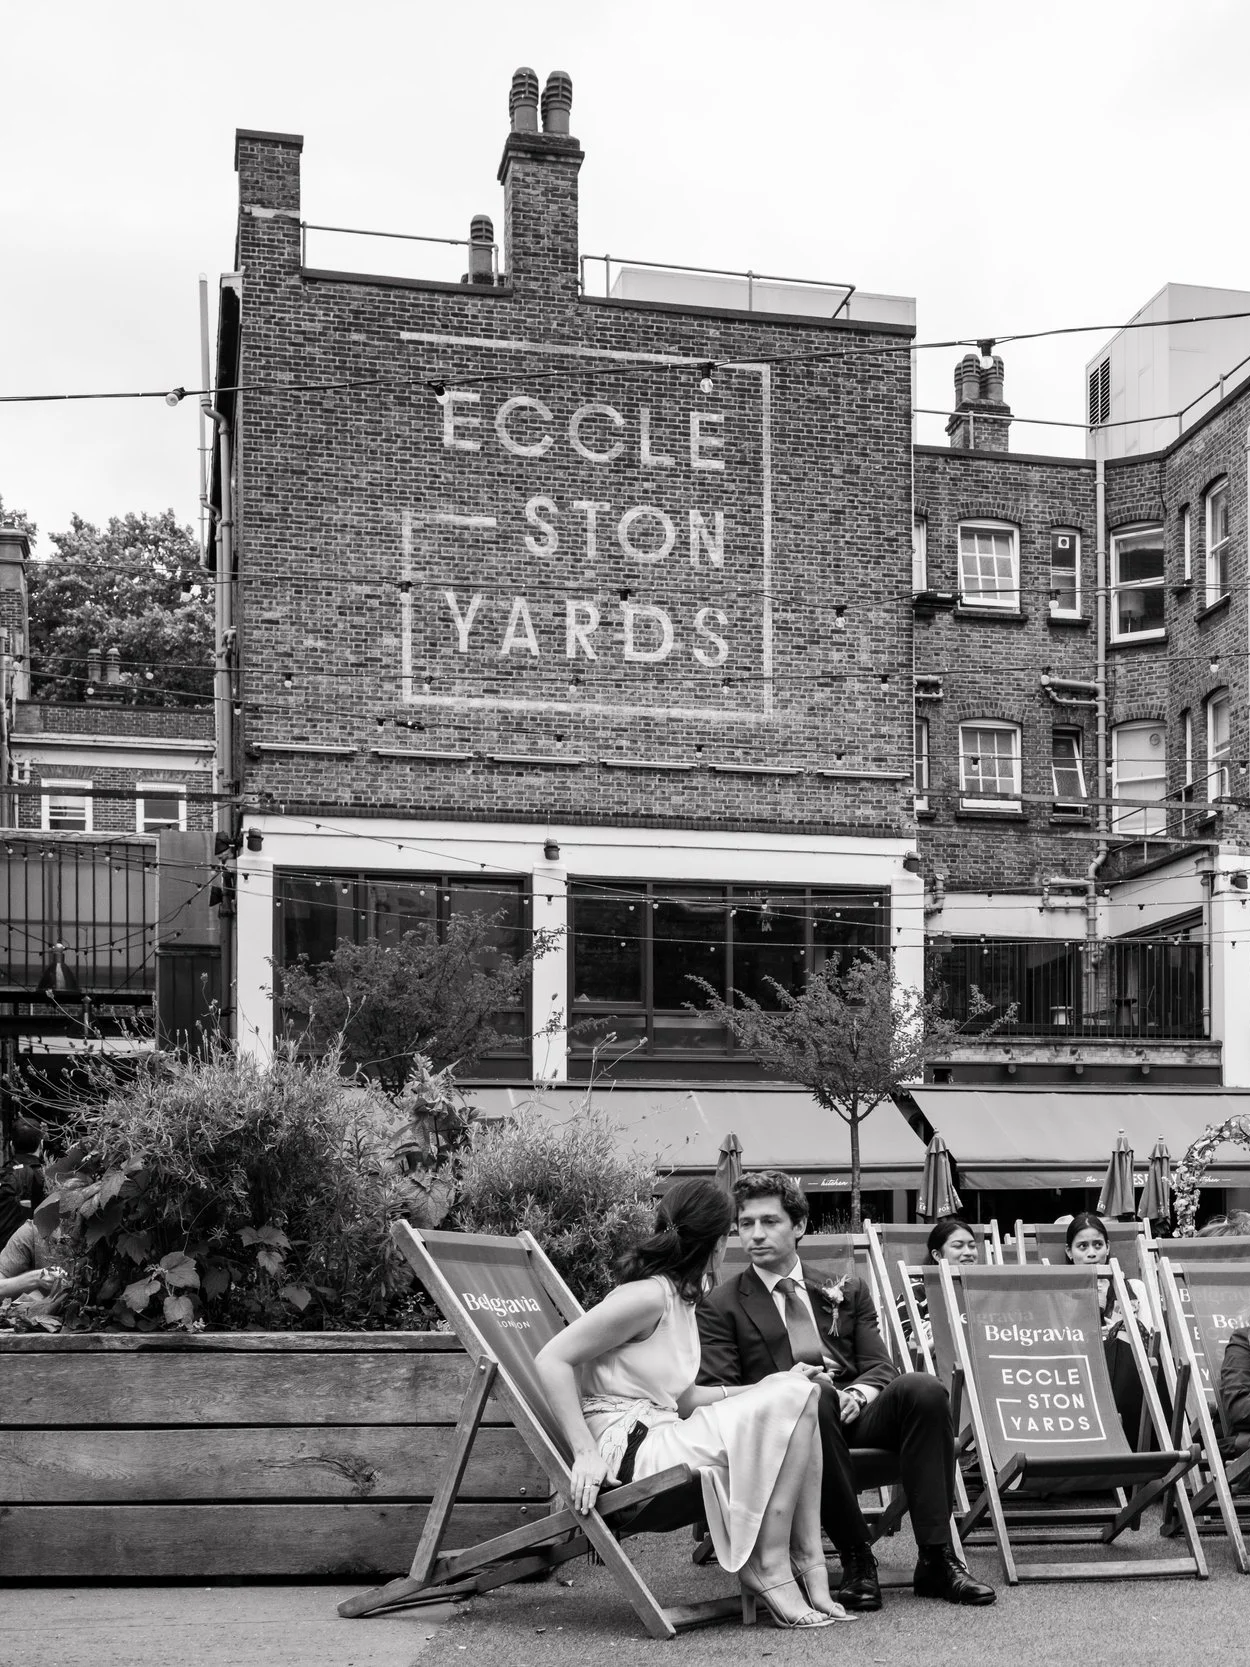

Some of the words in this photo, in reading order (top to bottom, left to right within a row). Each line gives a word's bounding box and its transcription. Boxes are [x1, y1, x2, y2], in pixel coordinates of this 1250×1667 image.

[443, 391, 725, 469] ECCLE
[524, 495, 725, 567] STON
[444, 591, 729, 667] YARDS
[821, 1178, 848, 1186] kitchen
[462, 1292, 541, 1317] Belgravia
[985, 1324, 1084, 1347] Belgravia
[1001, 1368, 1080, 1385] ECCLE
[1027, 1393, 1085, 1409] STON
[1010, 1416, 1090, 1431] YARDS
